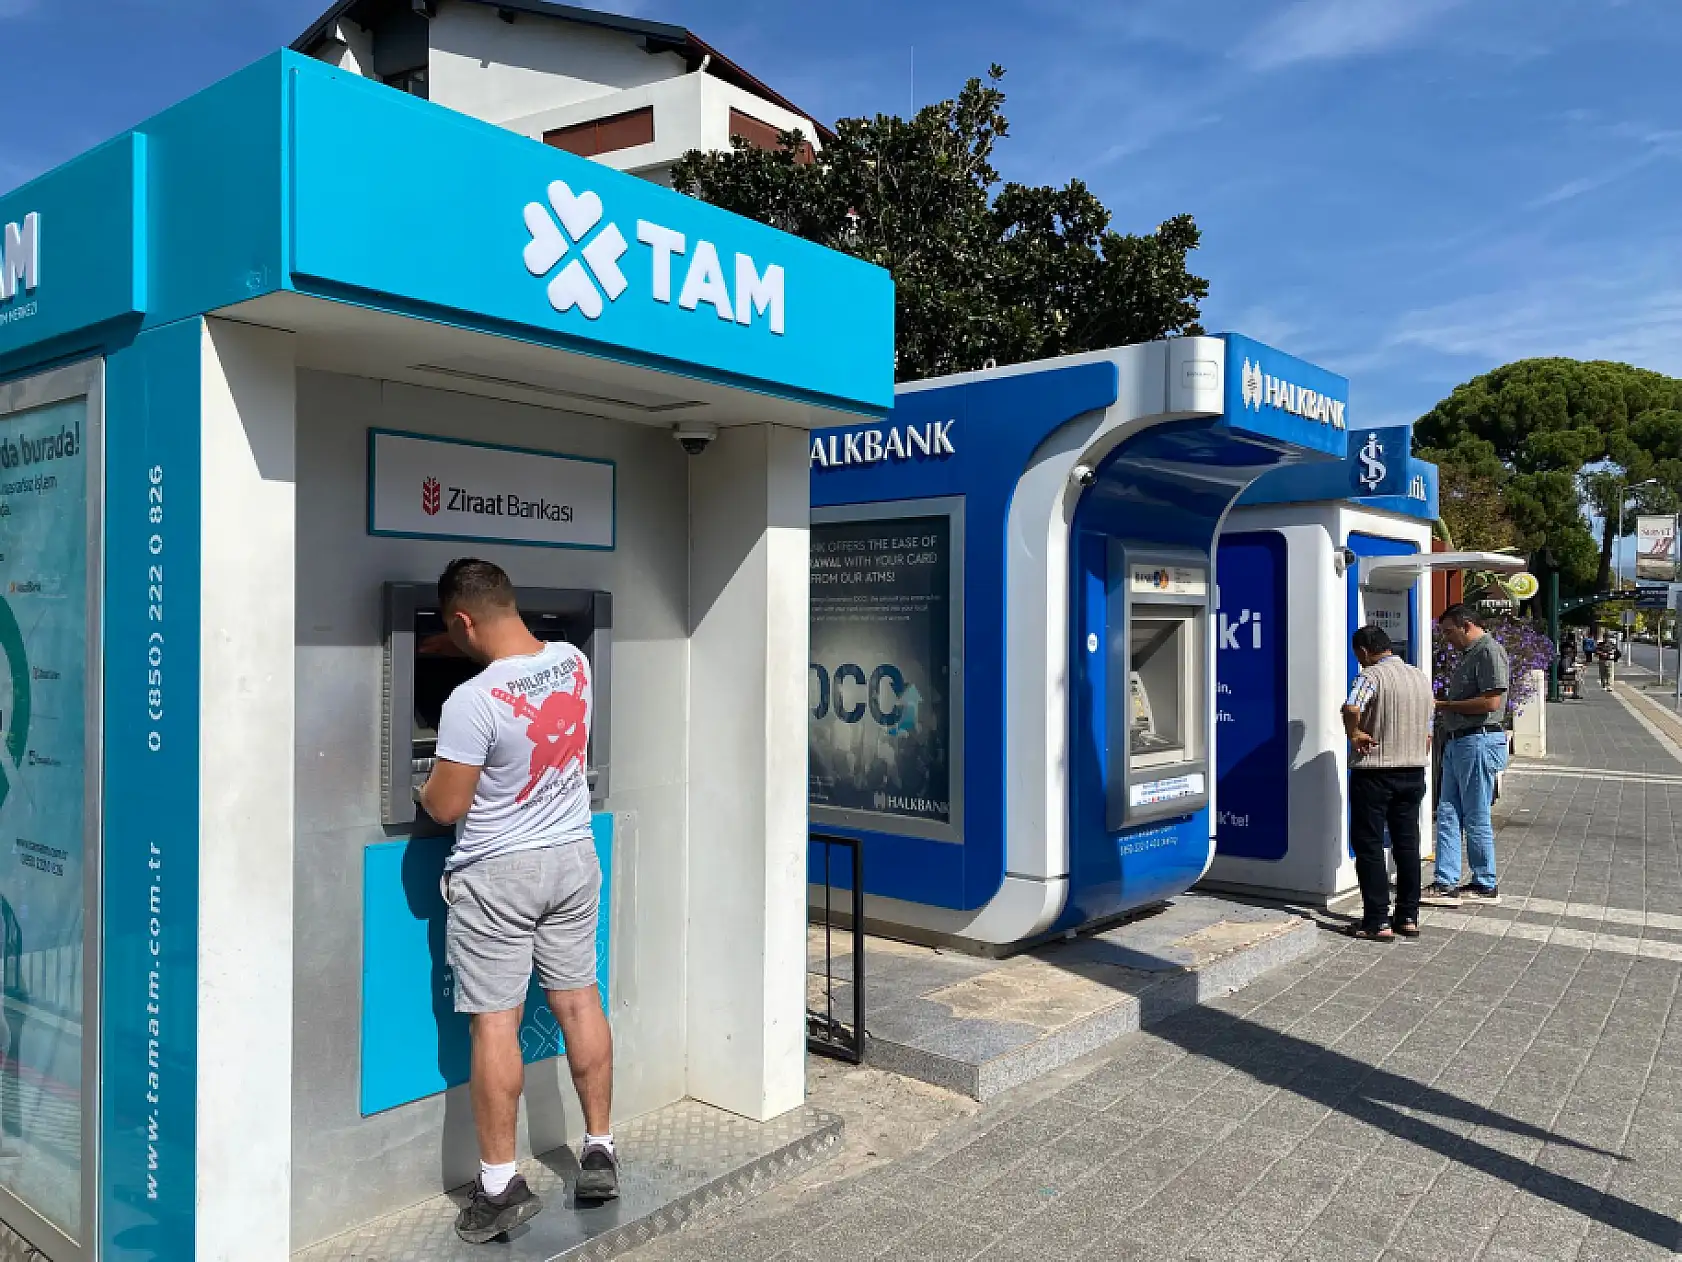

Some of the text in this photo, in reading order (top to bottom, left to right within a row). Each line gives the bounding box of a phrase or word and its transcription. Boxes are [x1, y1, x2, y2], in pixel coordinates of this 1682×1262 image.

[637, 219, 785, 334] TAM
[1264, 375, 1346, 429] HALKBANK
[20, 421, 81, 466] burada!
[149, 464, 163, 524] 826
[447, 487, 573, 523] Ziraat Bankası
[844, 555, 872, 568] WITH
[874, 554, 905, 567] YOUR
[907, 551, 938, 565] CARD
[867, 538, 890, 551] THE
[892, 536, 919, 549] EASE
[921, 535, 938, 547] OF
[149, 564, 163, 623] 222
[810, 573, 838, 584] FROM
[840, 571, 863, 584] OUR
[149, 632, 164, 720] (850)
[506, 669, 551, 694] PHILIPP
[888, 795, 949, 813] HALKBANK
[147, 842, 161, 1199] www.tamatm.com.tr
